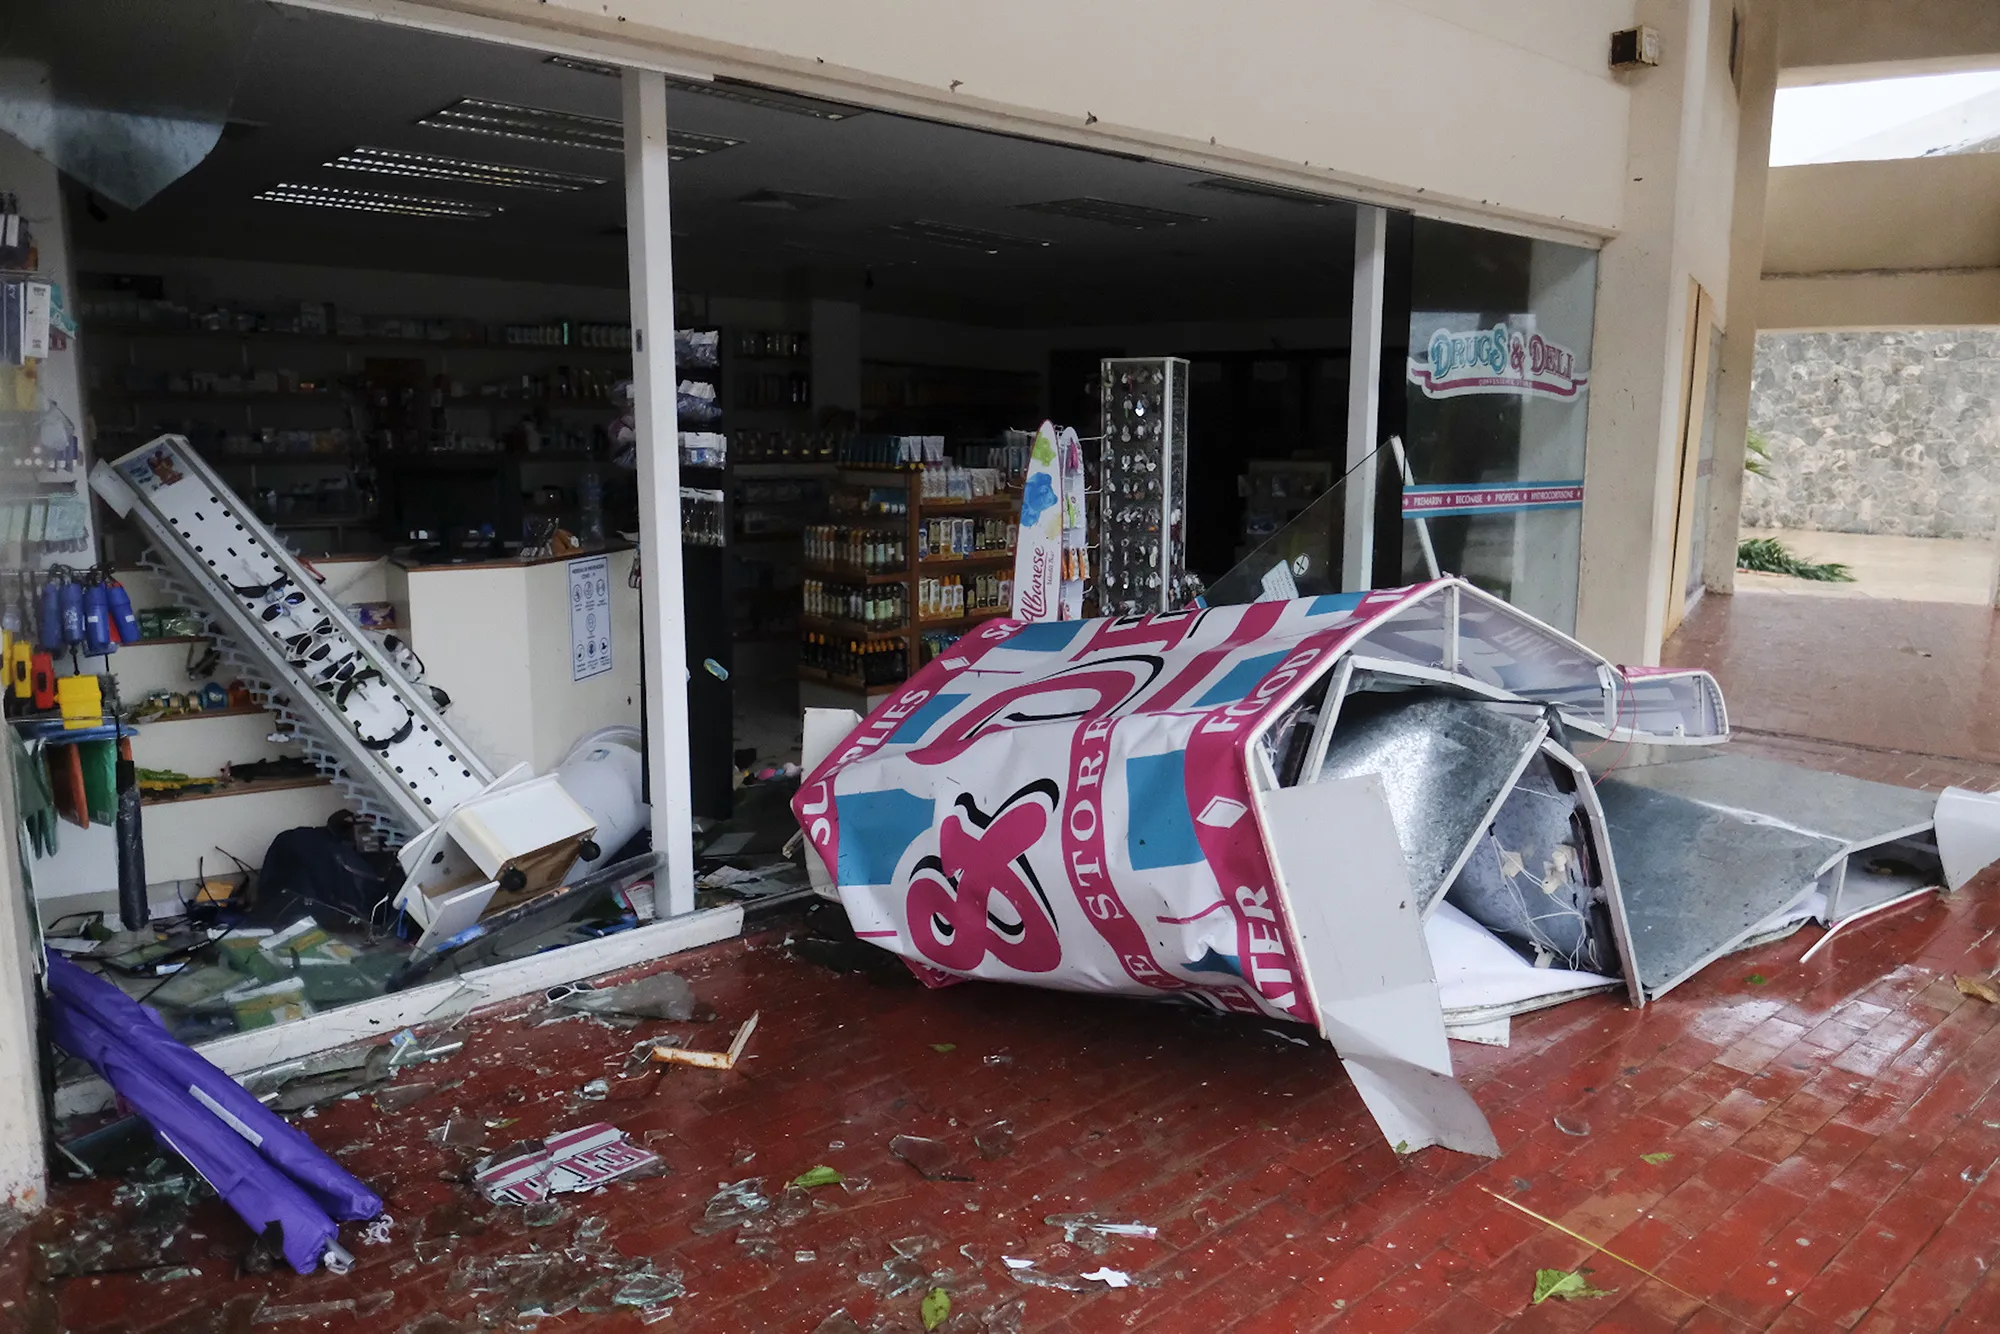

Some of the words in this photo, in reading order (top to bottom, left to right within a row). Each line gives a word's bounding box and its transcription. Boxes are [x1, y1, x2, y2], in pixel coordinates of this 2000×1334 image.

[1431, 326, 1507, 378] DRUGS
[1510, 340, 1525, 378] &
[1529, 335, 1574, 380] DELI
[1020, 545, 1046, 621] Albanese
[1202, 648, 1323, 735] FOOD
[803, 690, 931, 846] SUPLIES
[1068, 717, 1124, 920] STORE
